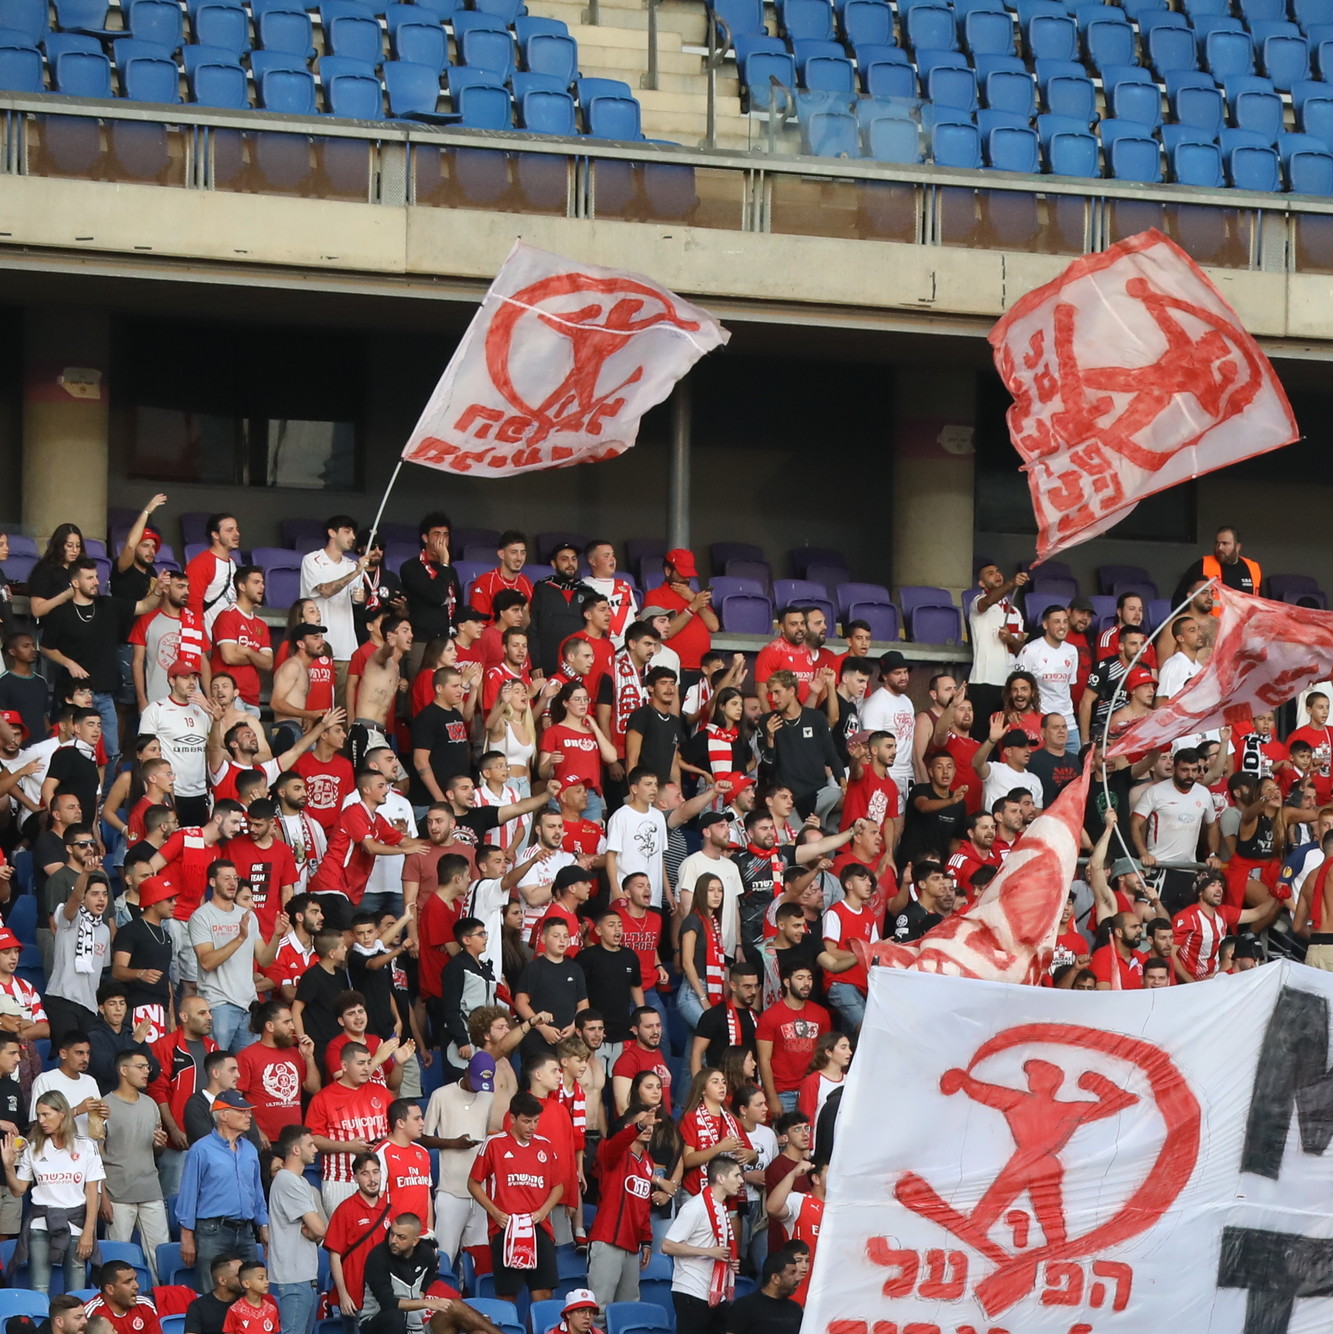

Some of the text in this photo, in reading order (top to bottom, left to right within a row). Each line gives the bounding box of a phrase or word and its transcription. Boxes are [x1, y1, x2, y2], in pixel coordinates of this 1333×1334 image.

[184, 716, 196, 728] 19
[37, 1172, 73, 1182] הכשרה
[866, 1210, 1133, 1313] הפועל
